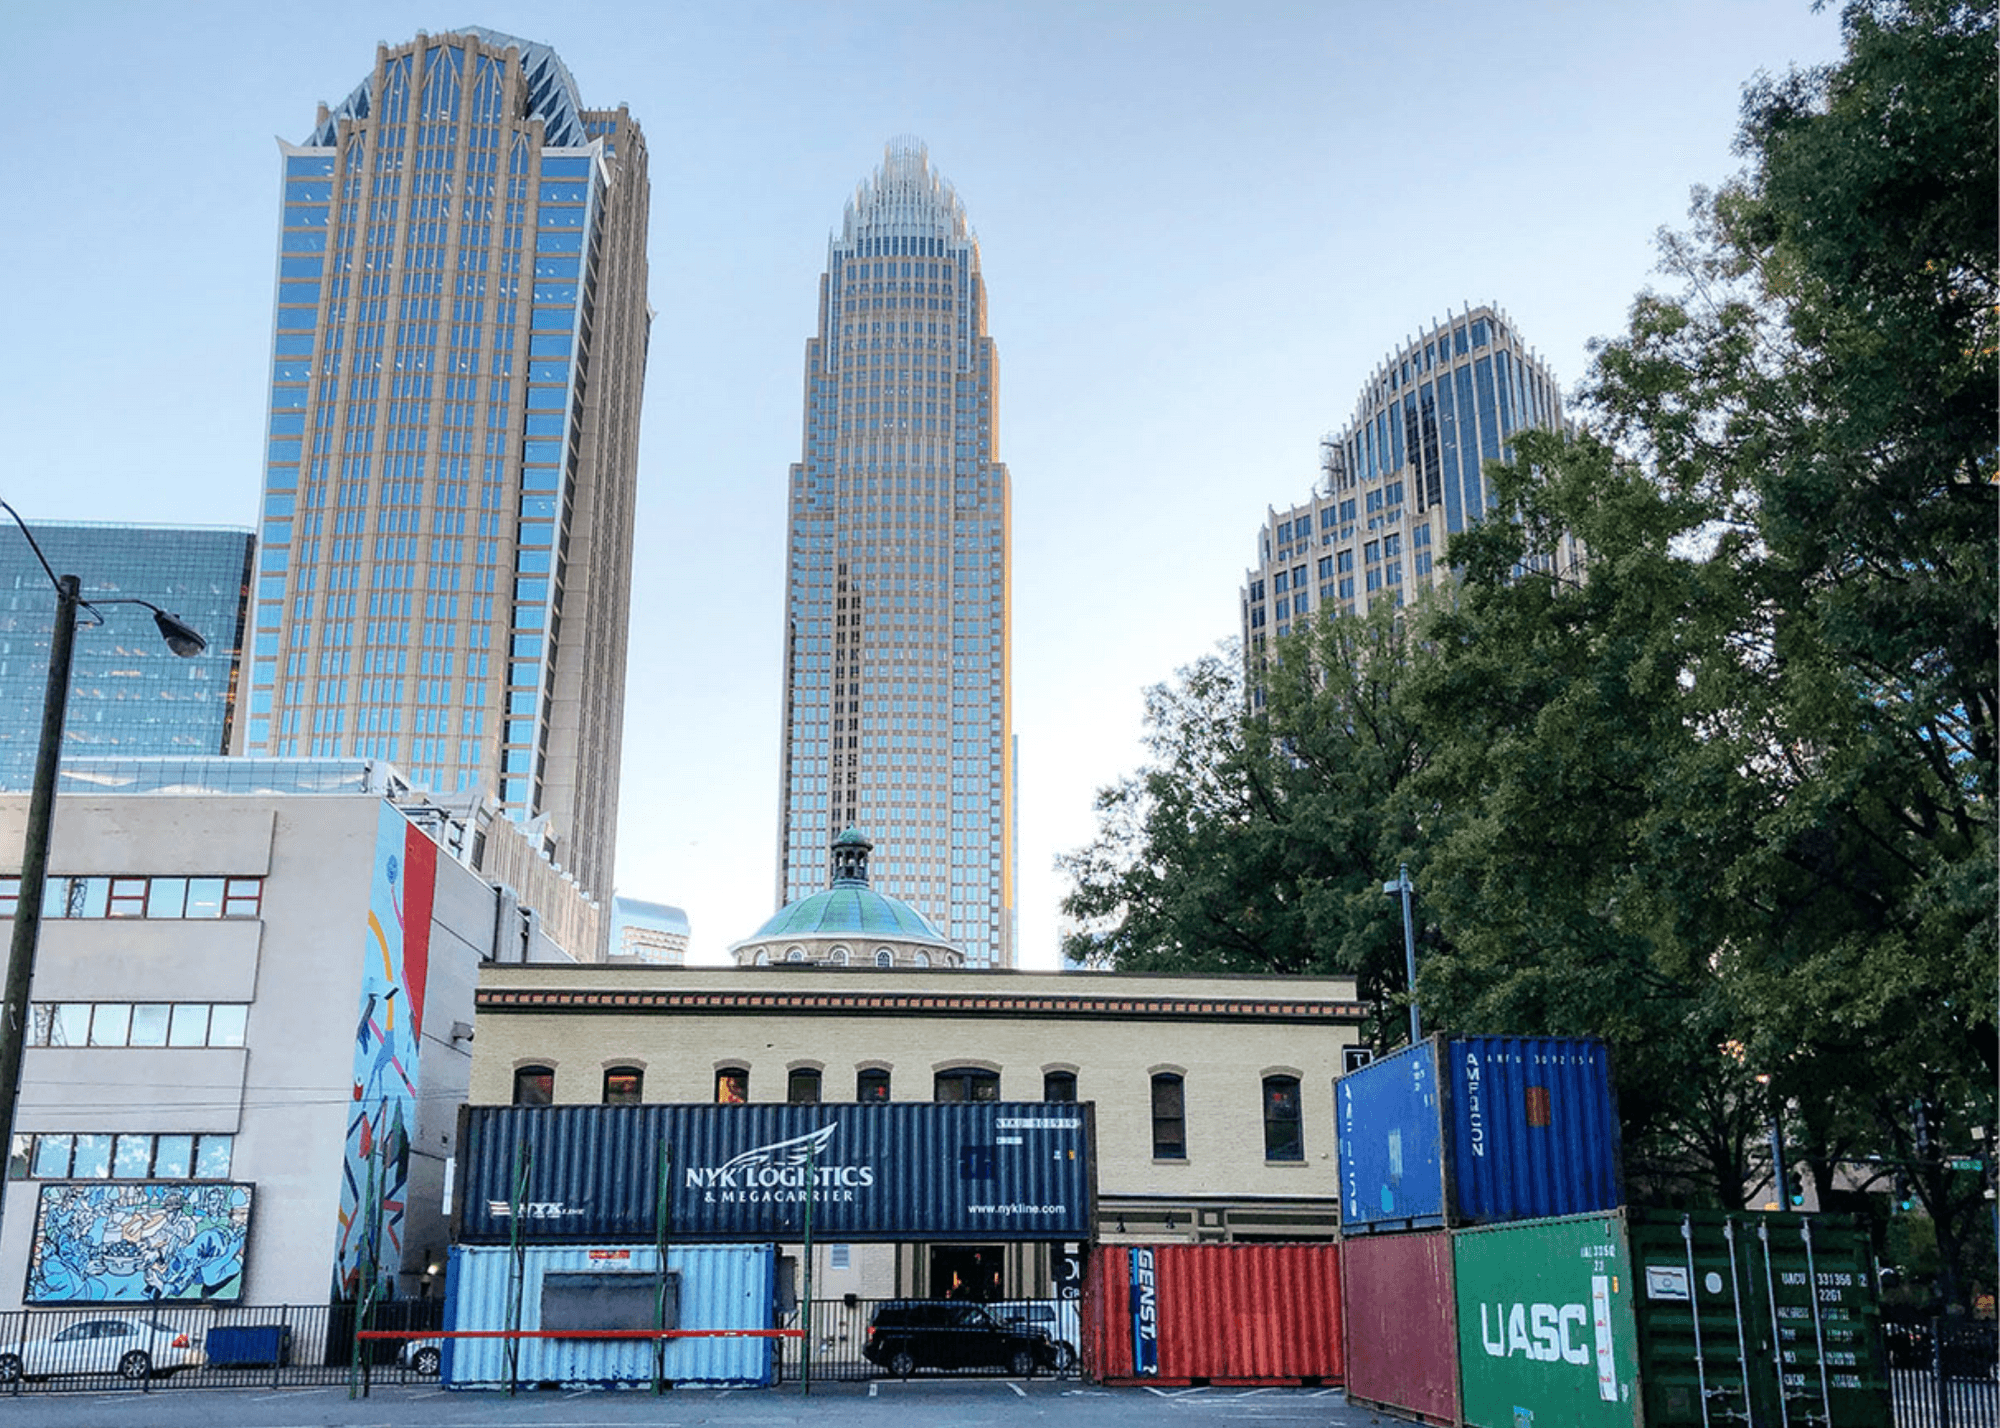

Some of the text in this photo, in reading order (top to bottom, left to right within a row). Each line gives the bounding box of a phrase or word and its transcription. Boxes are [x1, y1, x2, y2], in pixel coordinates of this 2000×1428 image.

[685, 1166, 874, 1187] NYK LOGISTICS
[704, 1190, 853, 1203] & MEGACARRIER
[968, 1203, 1066, 1216] www.nykline.com
[1857, 1273, 1868, 1288] 2
[1480, 1302, 1590, 1366] UASC
